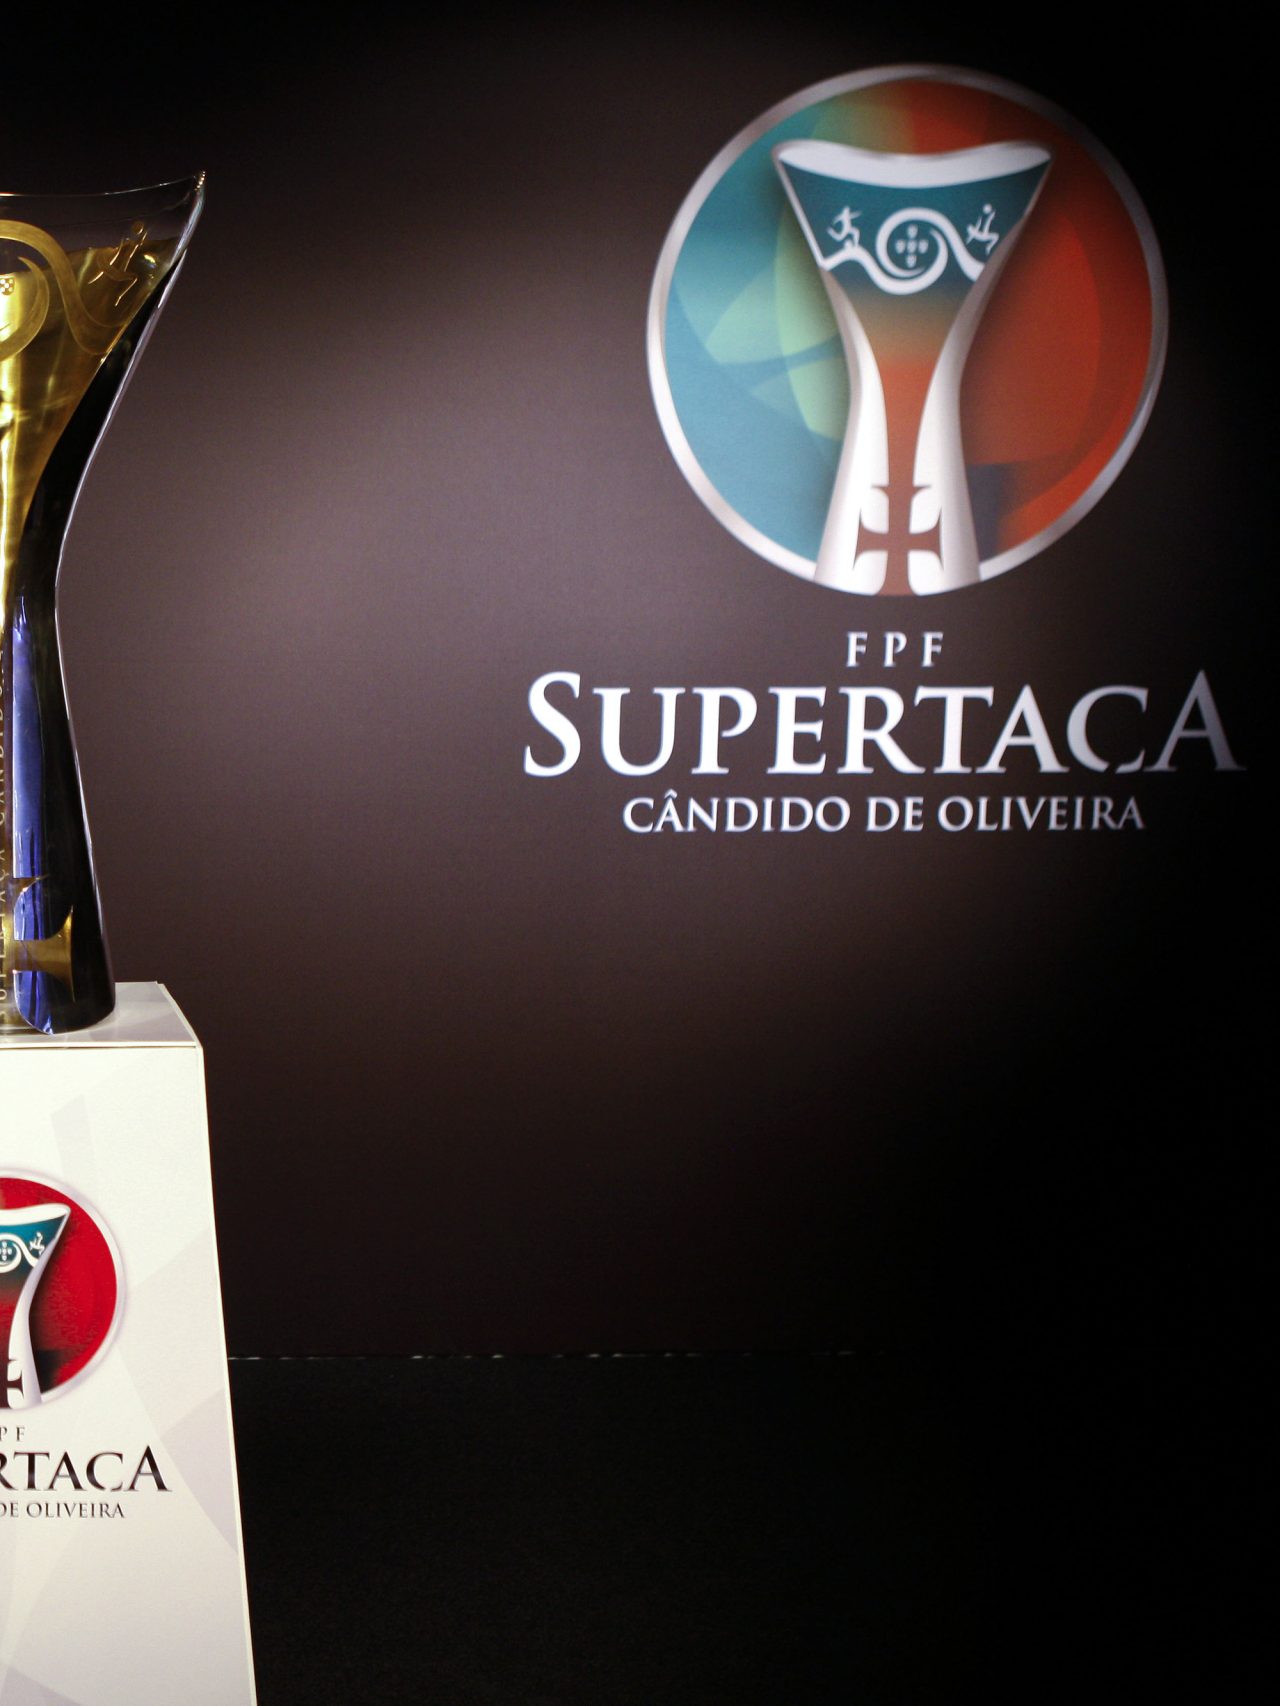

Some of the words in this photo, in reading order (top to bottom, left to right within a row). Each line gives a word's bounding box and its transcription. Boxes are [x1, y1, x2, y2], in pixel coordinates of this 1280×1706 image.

[623, 790, 850, 833] CÂNDIDO
[866, 796, 923, 832] DE
[937, 795, 1144, 832] OLIVEIRA
[26, 1502, 126, 1518] OLIVEIRA
